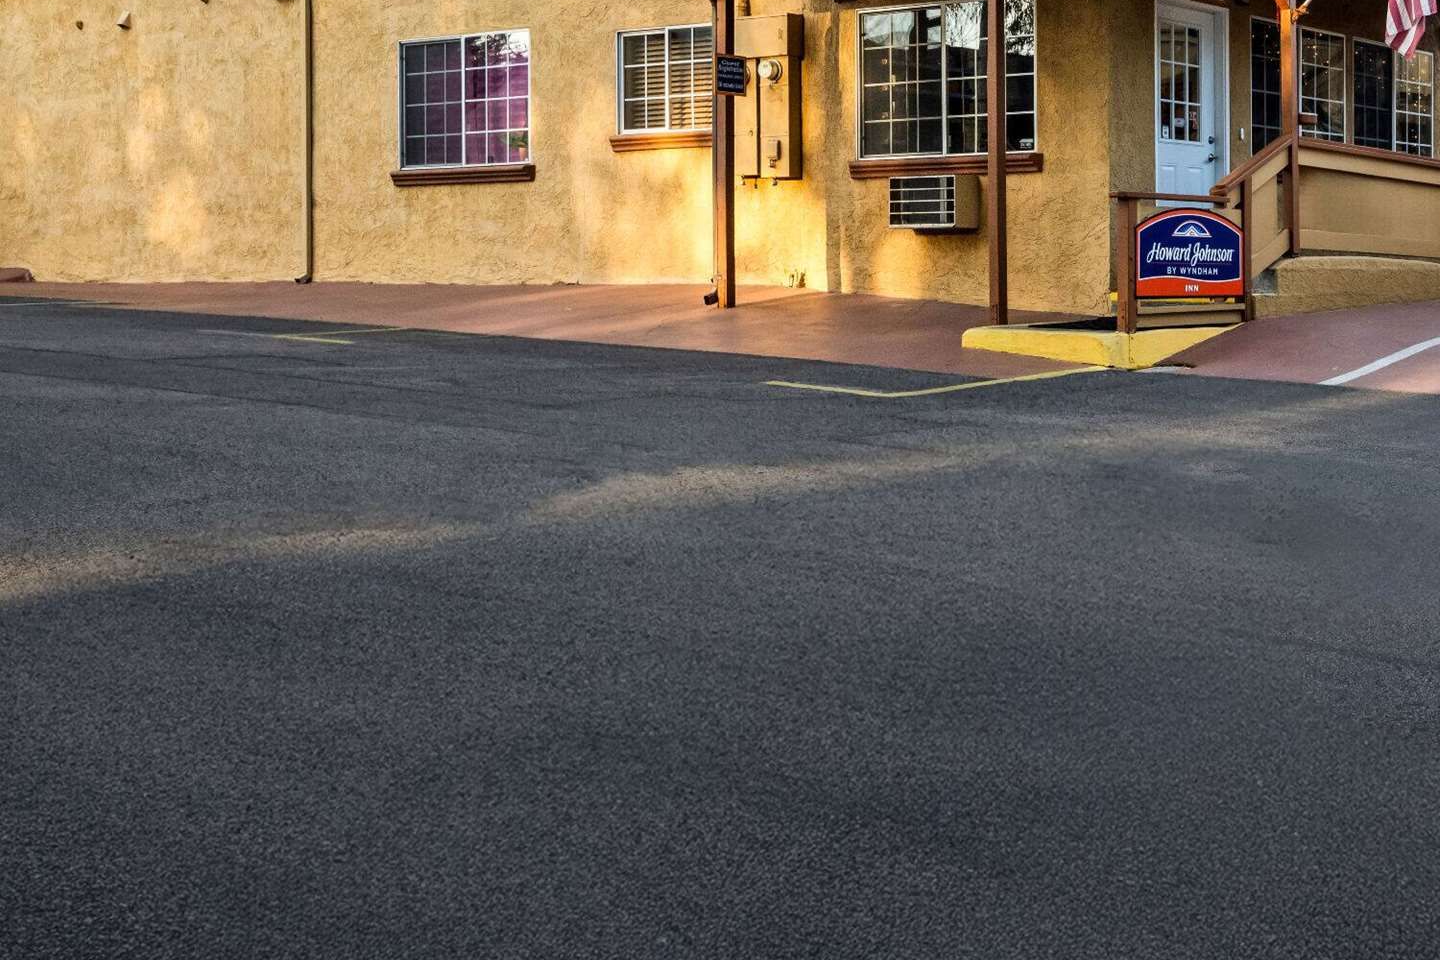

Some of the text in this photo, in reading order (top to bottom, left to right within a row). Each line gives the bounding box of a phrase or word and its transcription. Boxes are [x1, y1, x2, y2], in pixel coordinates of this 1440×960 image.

[1146, 242, 1235, 267] Howard Johnson
[1166, 266, 1218, 275] BY WYNDHAM
[1185, 284, 1199, 292] INN
